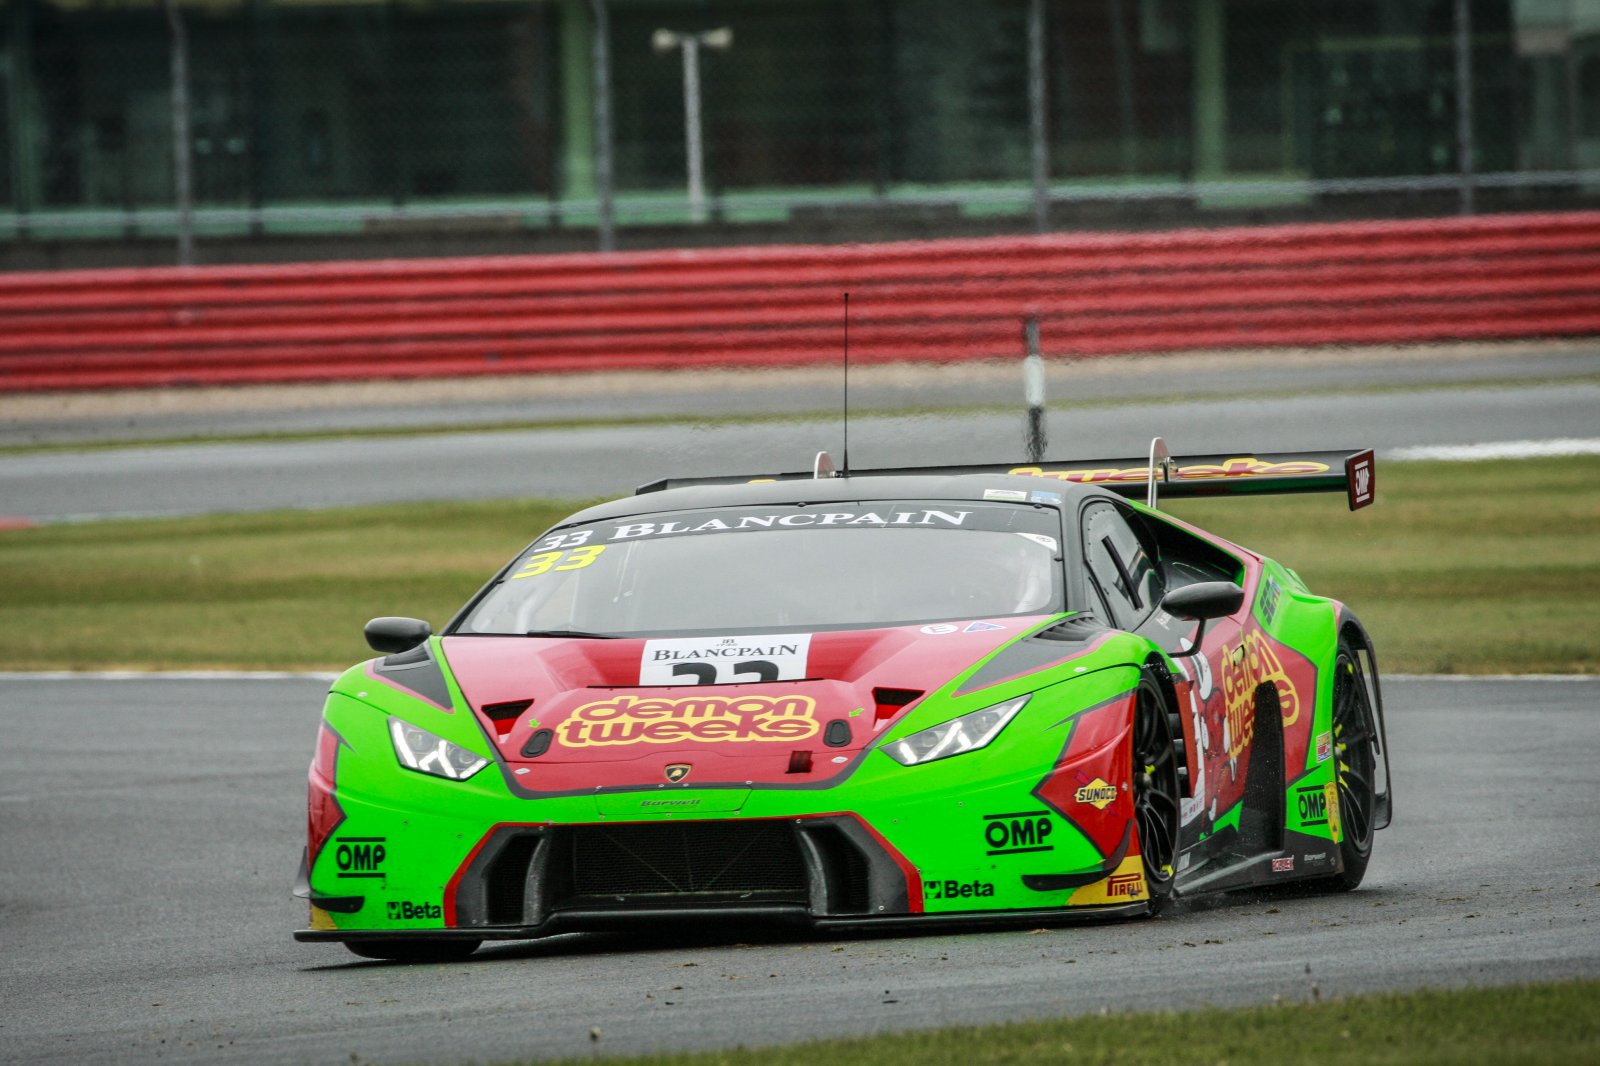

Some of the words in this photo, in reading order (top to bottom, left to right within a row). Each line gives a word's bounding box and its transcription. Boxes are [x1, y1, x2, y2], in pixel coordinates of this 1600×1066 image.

[1355, 467, 1370, 496] OMP
[607, 510, 974, 540] BLANCPAIN
[534, 530, 593, 553] 33
[511, 544, 607, 579] 33
[651, 644, 799, 661] BLANCPAIN
[570, 694, 818, 722] demon
[555, 714, 821, 748] tweeks
[1078, 787, 1116, 802] SUNOCO
[1298, 792, 1327, 820] OMP
[985, 817, 1053, 848] OMP
[336, 844, 386, 871] OMP
[945, 880, 994, 899] Beta
[402, 901, 442, 920] Beta
